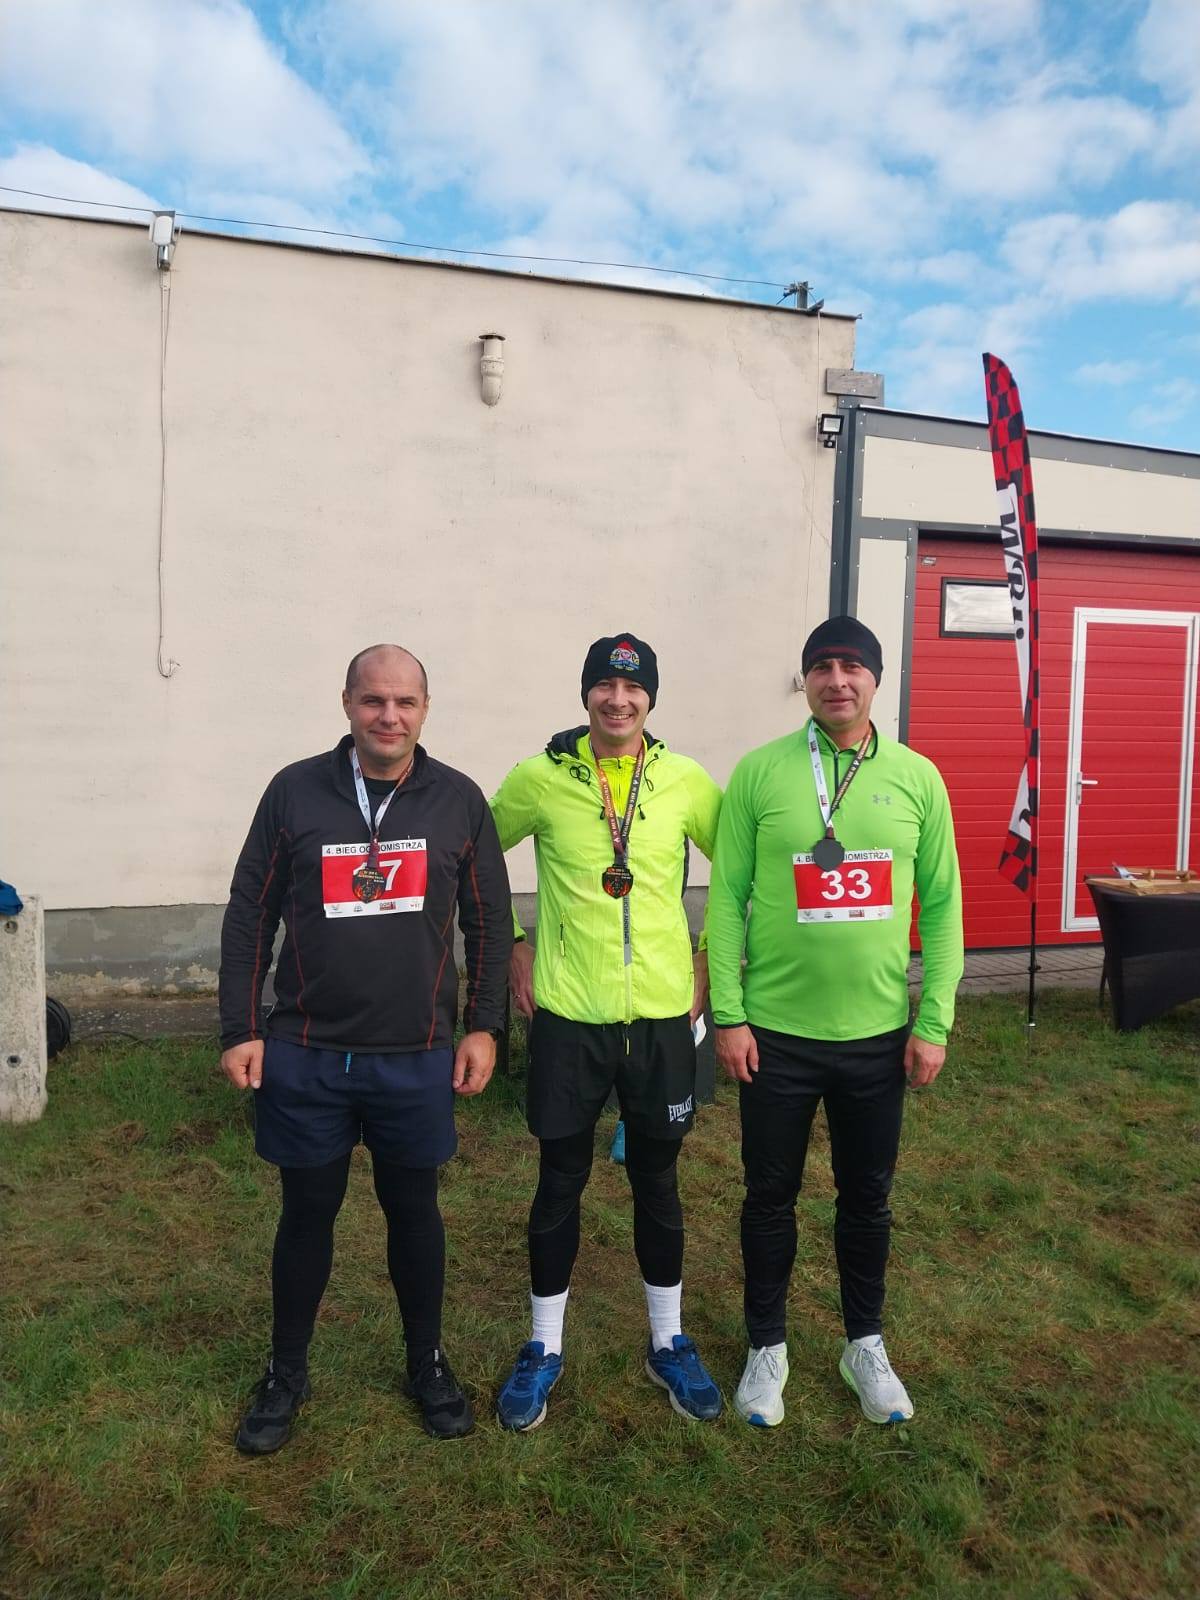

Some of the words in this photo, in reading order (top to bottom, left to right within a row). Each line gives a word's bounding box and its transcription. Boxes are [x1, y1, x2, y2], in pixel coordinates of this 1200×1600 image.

[335, 846, 357, 855] BIEG
[359, 841, 423, 853] OGOMISTRZA
[844, 851, 890, 861] IOMISTRZA
[820, 868, 872, 900] 33
